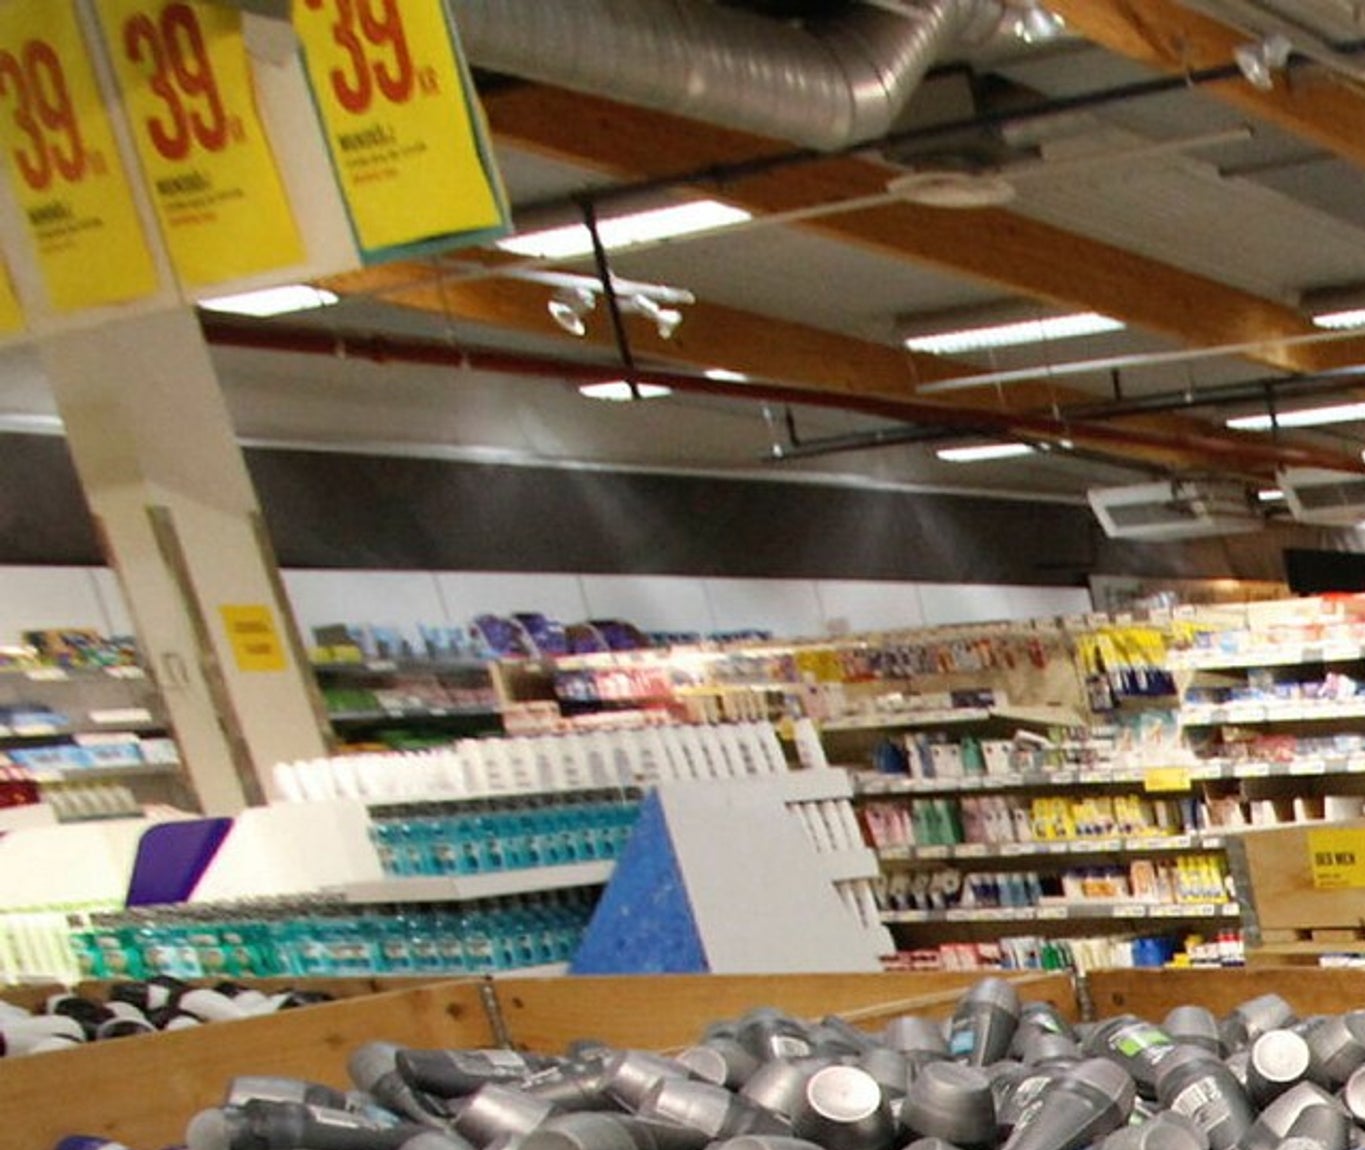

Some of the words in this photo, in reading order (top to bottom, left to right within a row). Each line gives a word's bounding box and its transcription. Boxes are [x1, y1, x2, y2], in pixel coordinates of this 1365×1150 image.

[0, 40, 85, 189] 39
[123, 3, 228, 161] 39
[300, 0, 414, 116] 39
